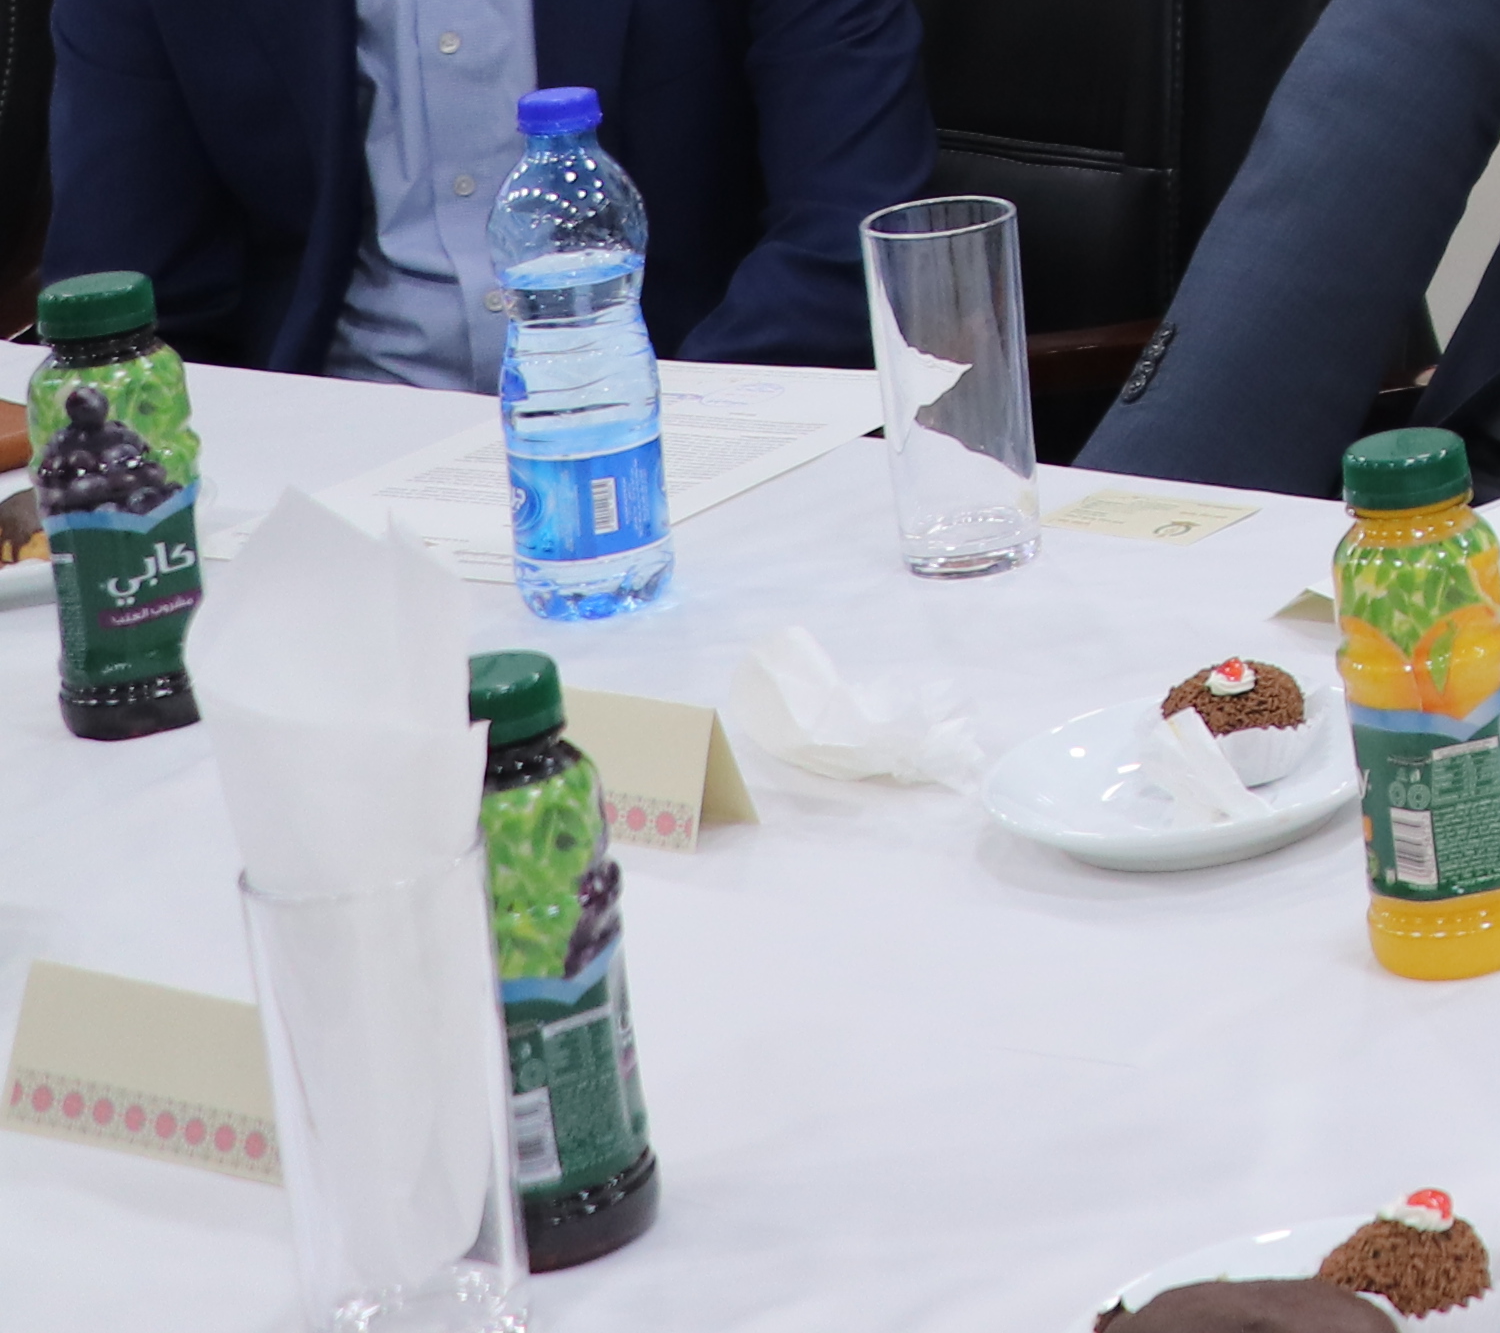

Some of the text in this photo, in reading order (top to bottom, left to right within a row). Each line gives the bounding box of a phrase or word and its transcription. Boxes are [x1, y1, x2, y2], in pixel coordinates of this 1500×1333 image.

[107, 542, 196, 607] كابي
[111, 594, 194, 626] مشروب العنب
